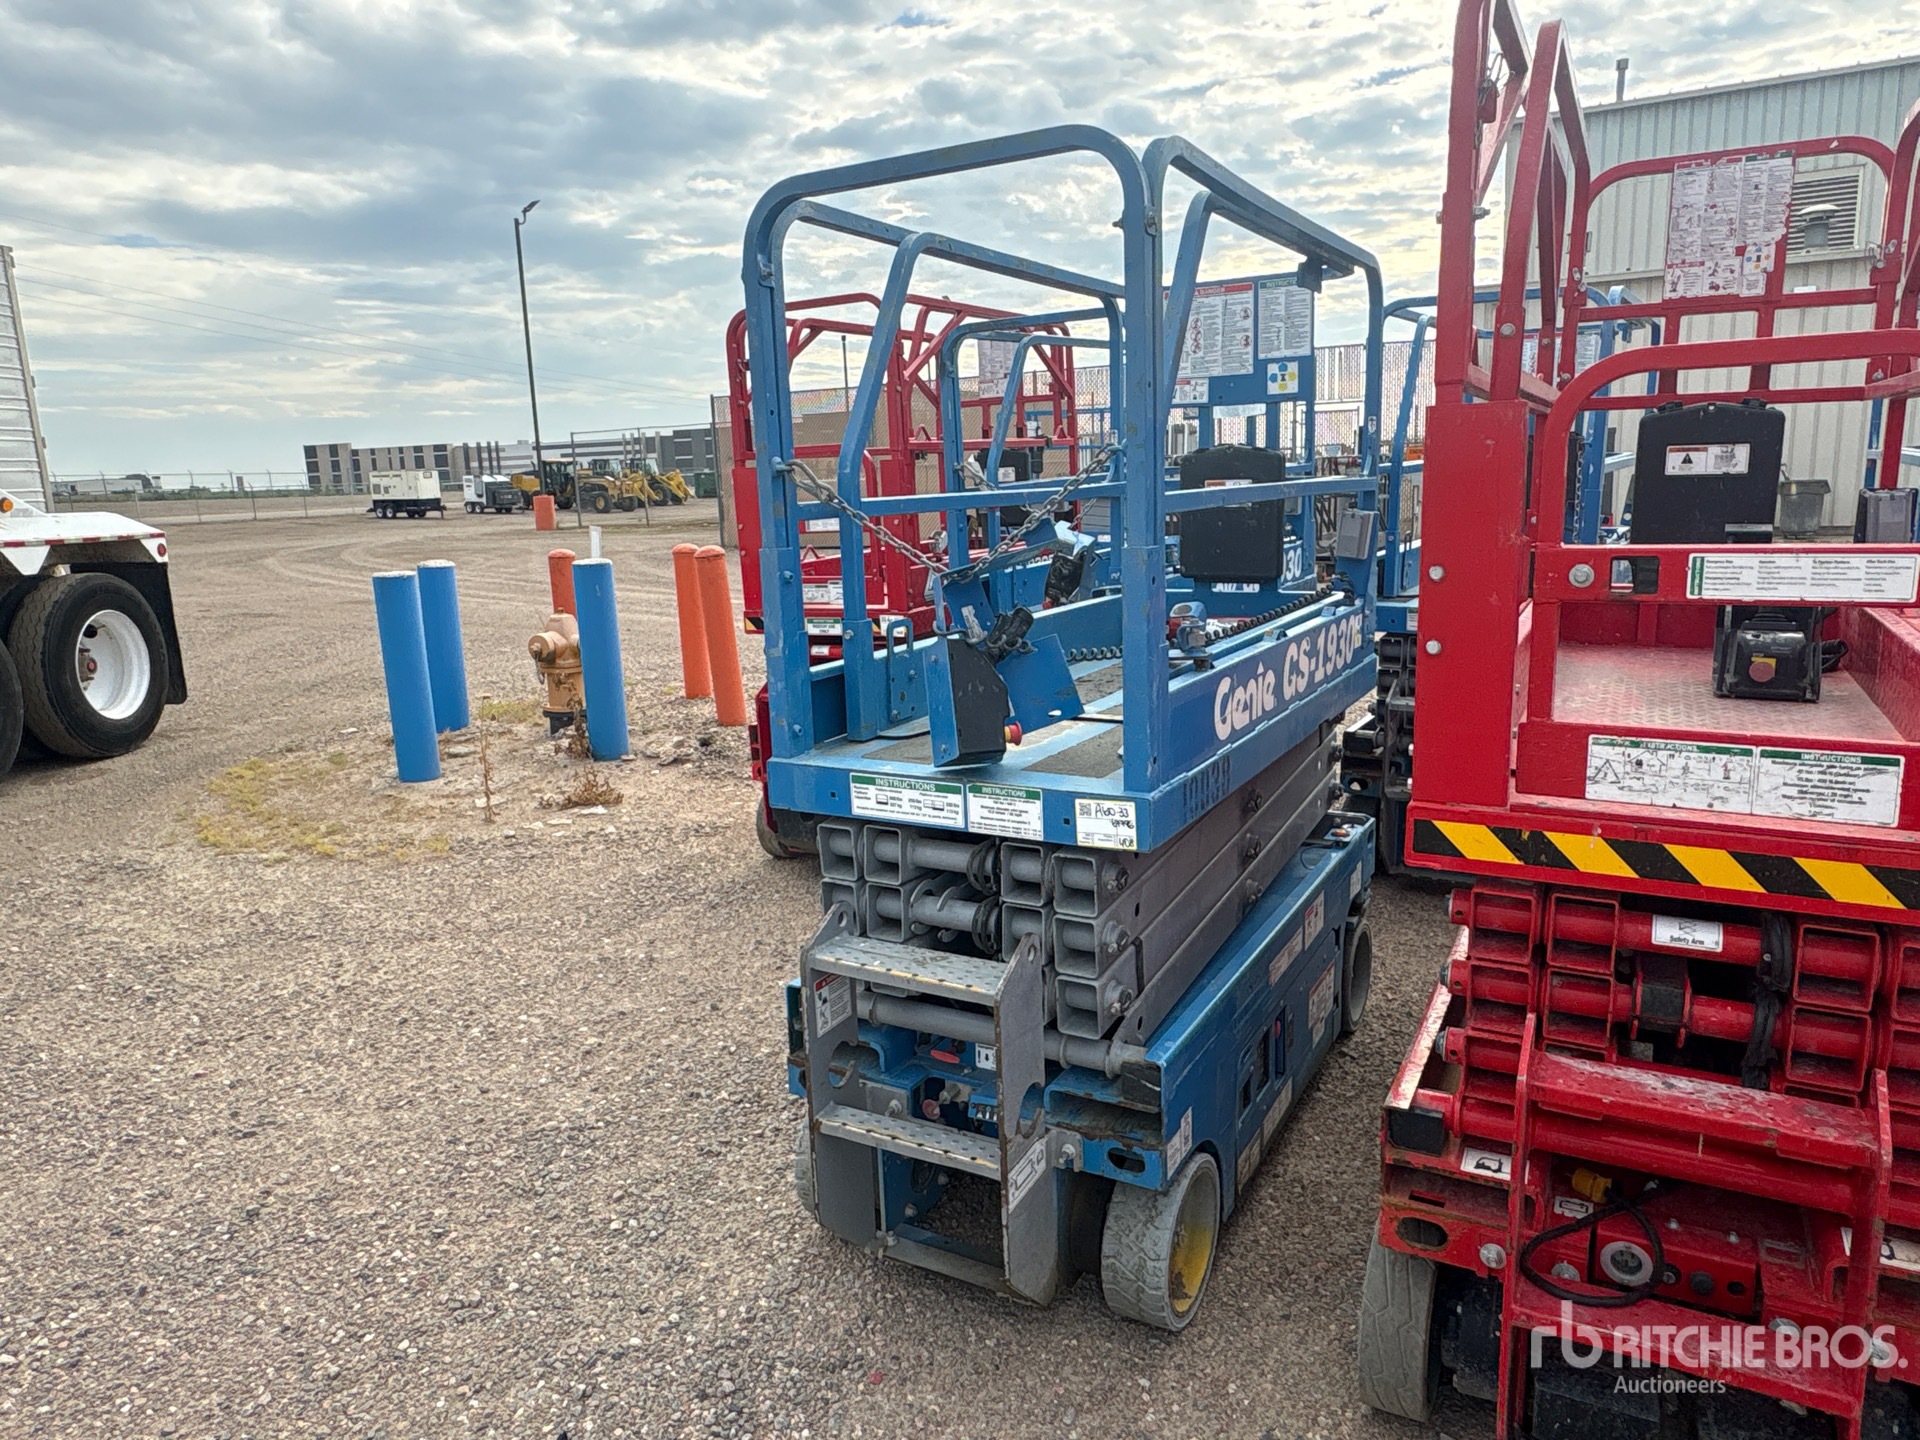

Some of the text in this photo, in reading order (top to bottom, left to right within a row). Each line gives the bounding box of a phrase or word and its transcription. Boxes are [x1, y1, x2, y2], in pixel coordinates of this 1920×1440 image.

[1282, 547, 1302, 583] 30
[1214, 661, 1276, 741] Genie
[1801, 753, 1862, 764] INSTRUCTIONS
[875, 778, 936, 792] INSTRUCTIONS
[981, 787, 1026, 798] INSTRUCTIONS
